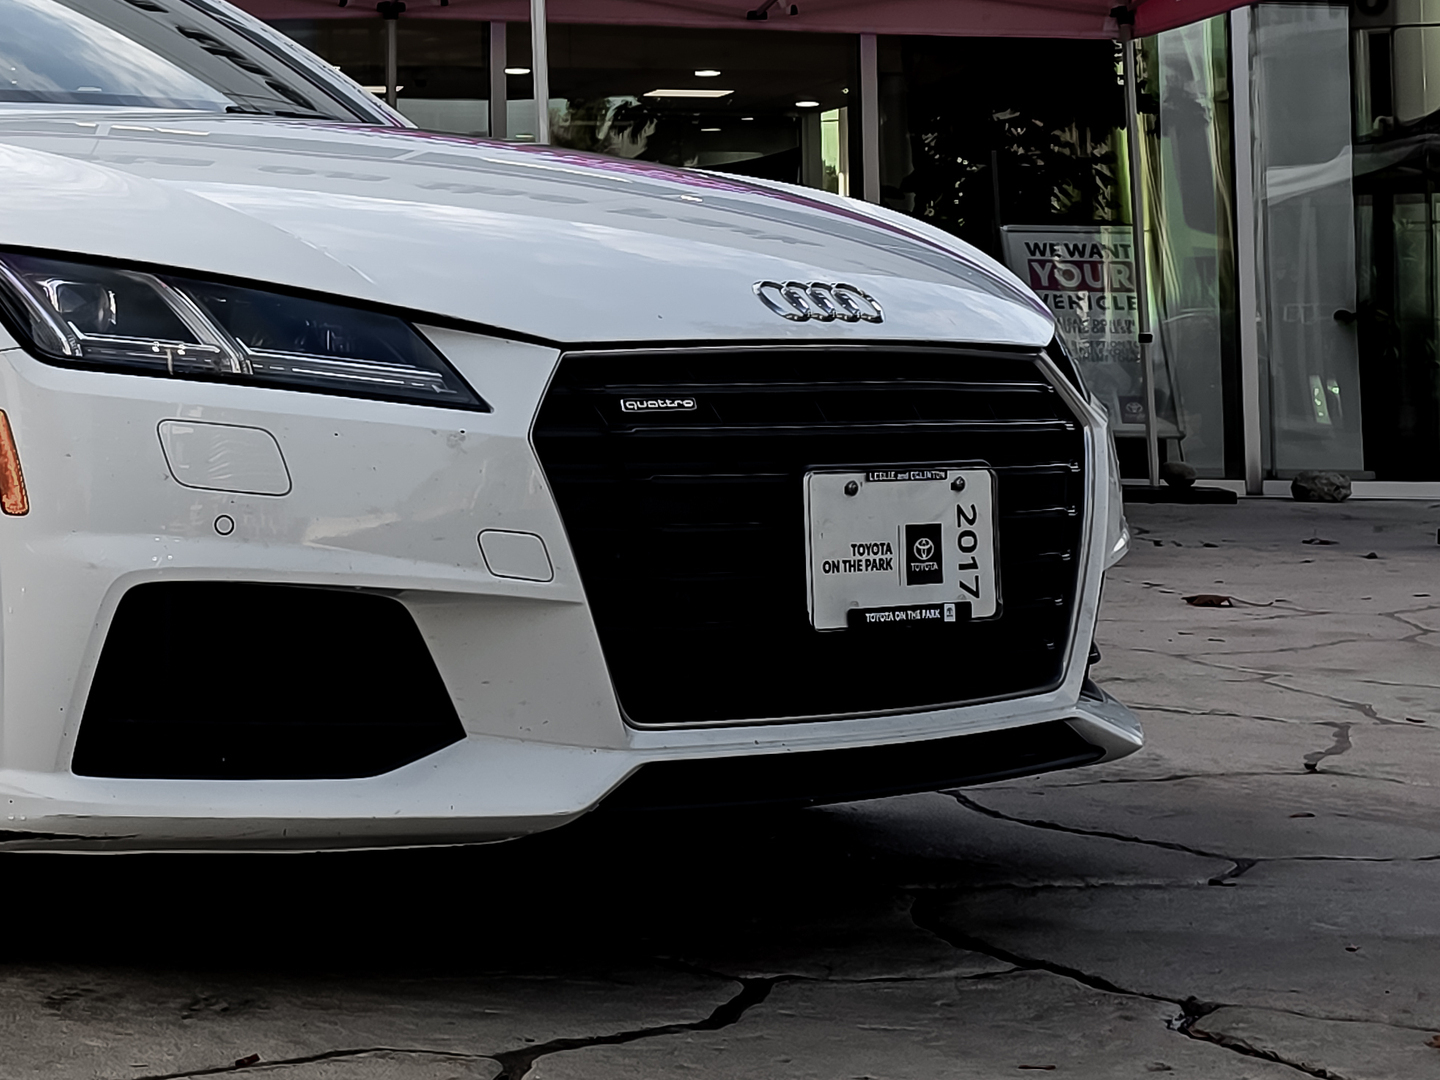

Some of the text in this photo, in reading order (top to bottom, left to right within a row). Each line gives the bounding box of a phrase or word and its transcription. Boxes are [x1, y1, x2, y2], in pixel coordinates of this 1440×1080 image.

[1025, 242, 1131, 259] WE WANT
[1030, 262, 1135, 289] YOUR
[625, 398, 694, 410] quattro
[851, 542, 893, 557] TOYOTA
[956, 503, 980, 599] 2017
[822, 557, 893, 574] ON THE PARK
[895, 610, 907, 621] ON
[922, 608, 941, 619] PARK
